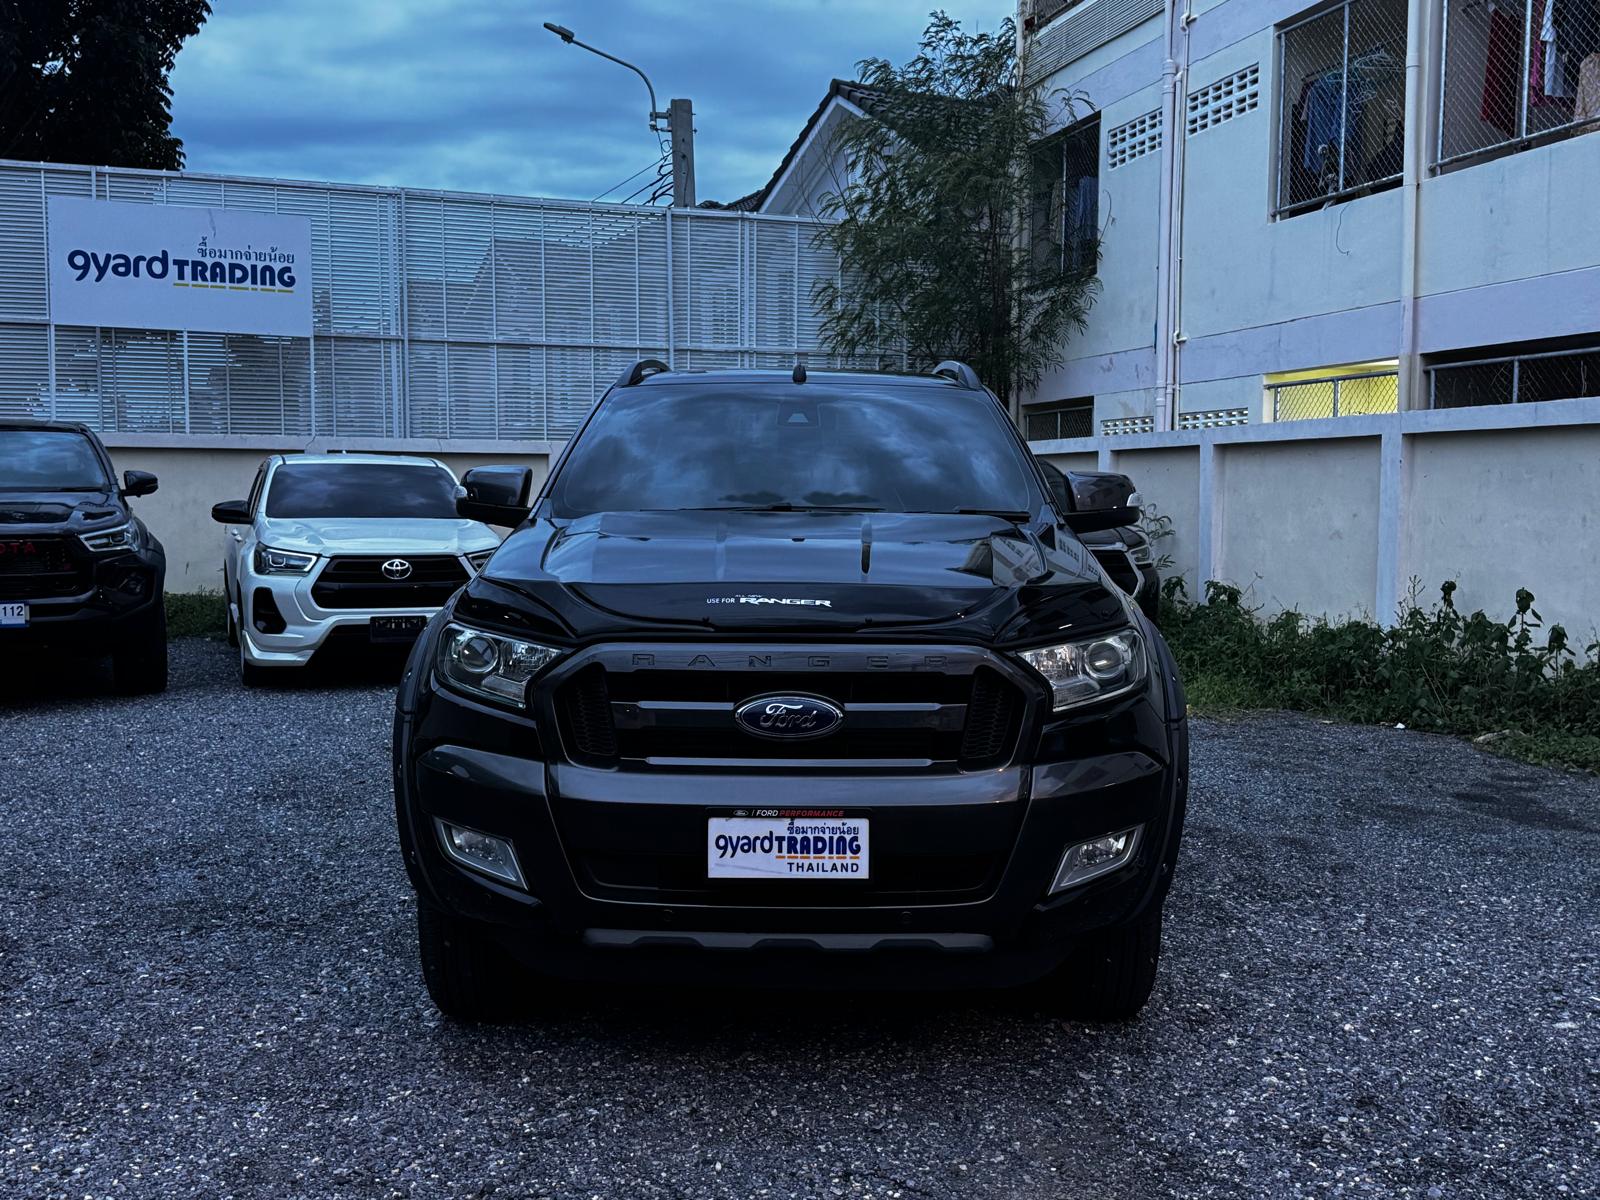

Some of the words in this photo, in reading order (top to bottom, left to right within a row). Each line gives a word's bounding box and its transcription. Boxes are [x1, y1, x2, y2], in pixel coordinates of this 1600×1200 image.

[197, 237, 295, 264] ซื้อมากจ่ายน้อย
[67, 249, 168, 282] 9yard
[173, 258, 296, 288] TRADING
[739, 596, 832, 607] RANGER
[631, 653, 949, 669] RANGER
[760, 703, 817, 727] Ford
[715, 831, 773, 858] 9yard
[775, 836, 861, 855] TRADING
[787, 862, 860, 873] THAILAND
